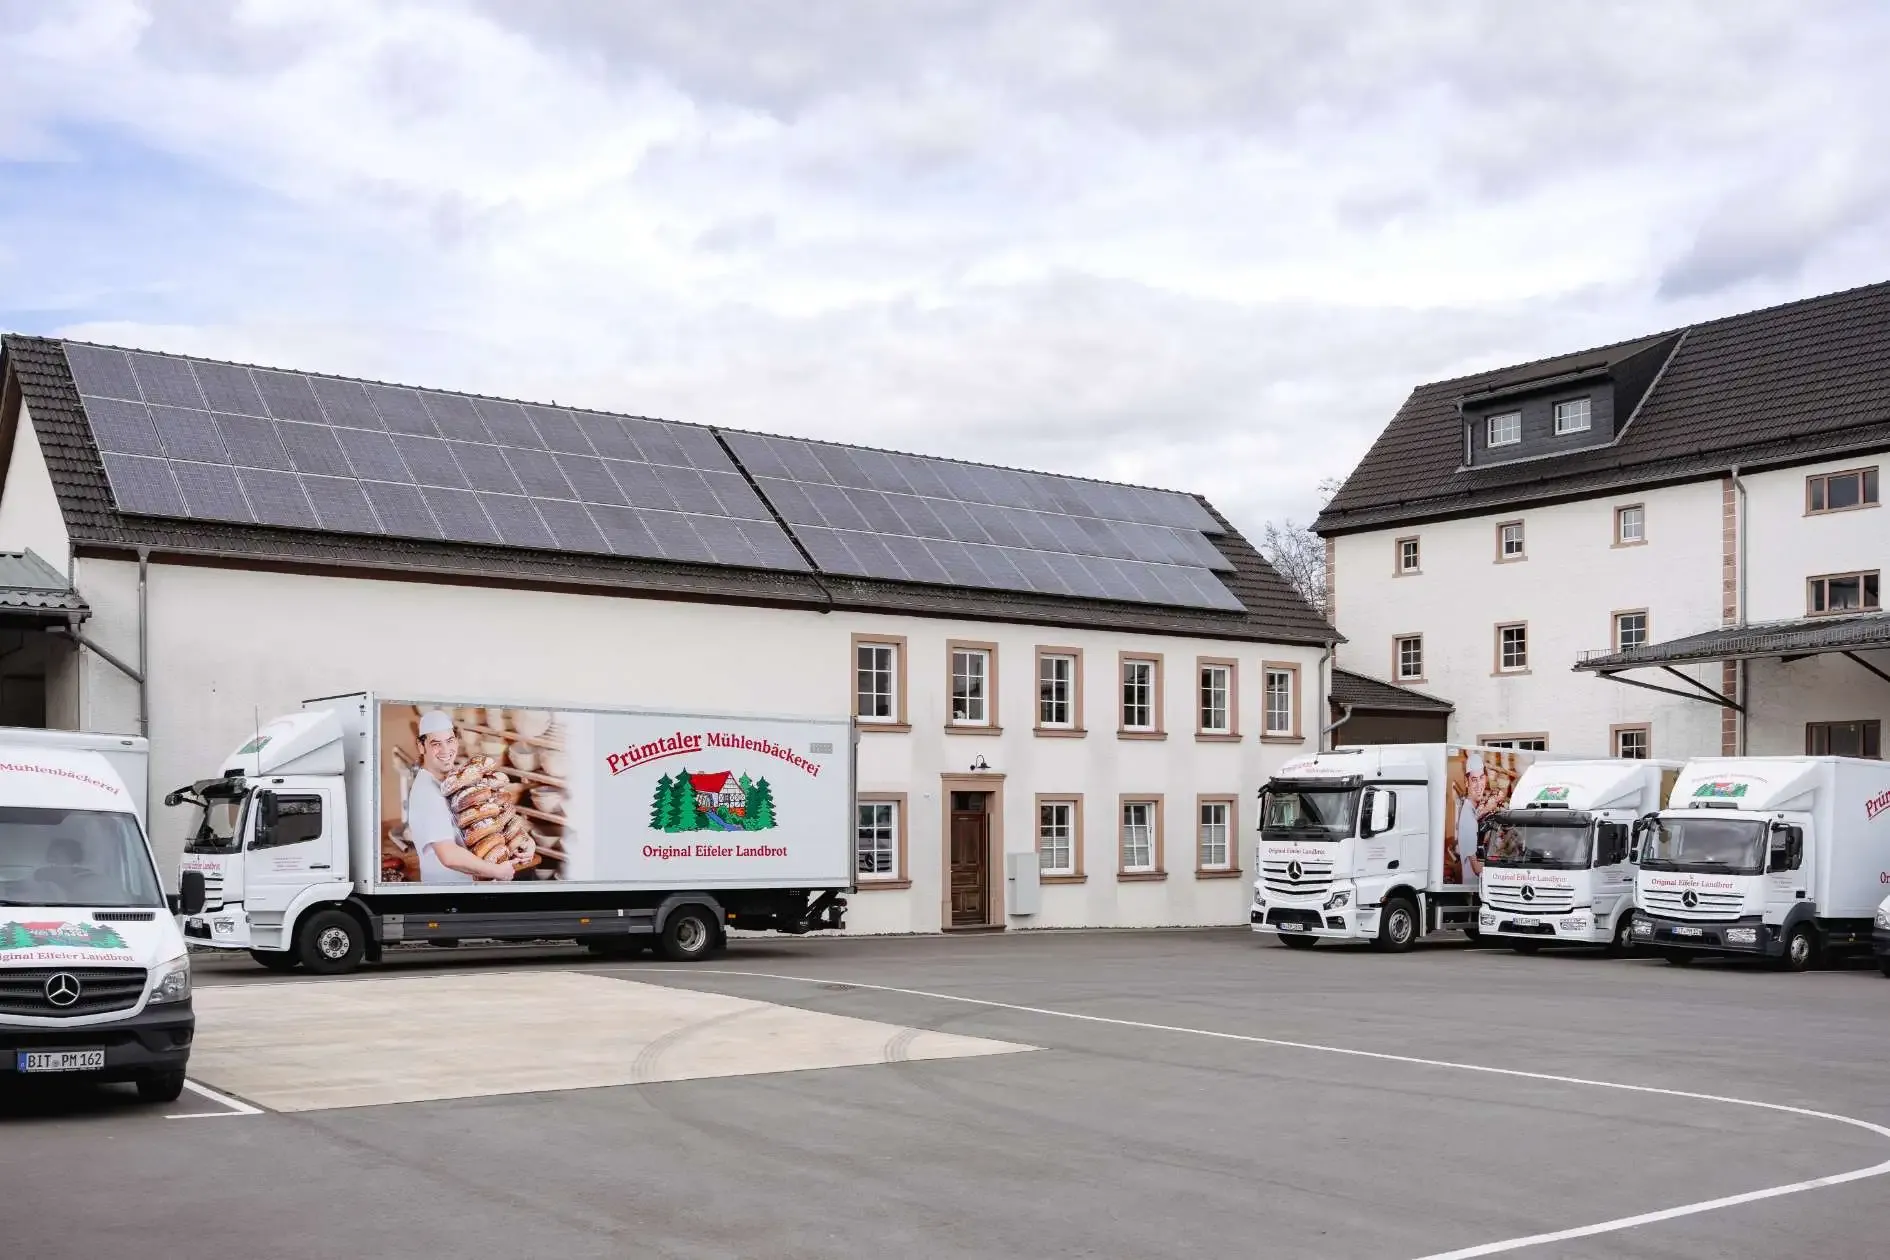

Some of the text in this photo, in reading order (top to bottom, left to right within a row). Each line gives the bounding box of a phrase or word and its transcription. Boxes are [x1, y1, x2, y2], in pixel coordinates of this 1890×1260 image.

[606, 731, 821, 777] Prümtaler Mühlenbäckerei
[643, 845, 788, 859] Original Eifeler Landbrot
[1651, 878, 1676, 887] Original
[38, 952, 80, 960] Eifeler
[82, 952, 135, 962] Landbrot
[28, 1054, 52, 1068] BIT
[61, 1054, 78, 1067] PM
[80, 1052, 102, 1066] 162
